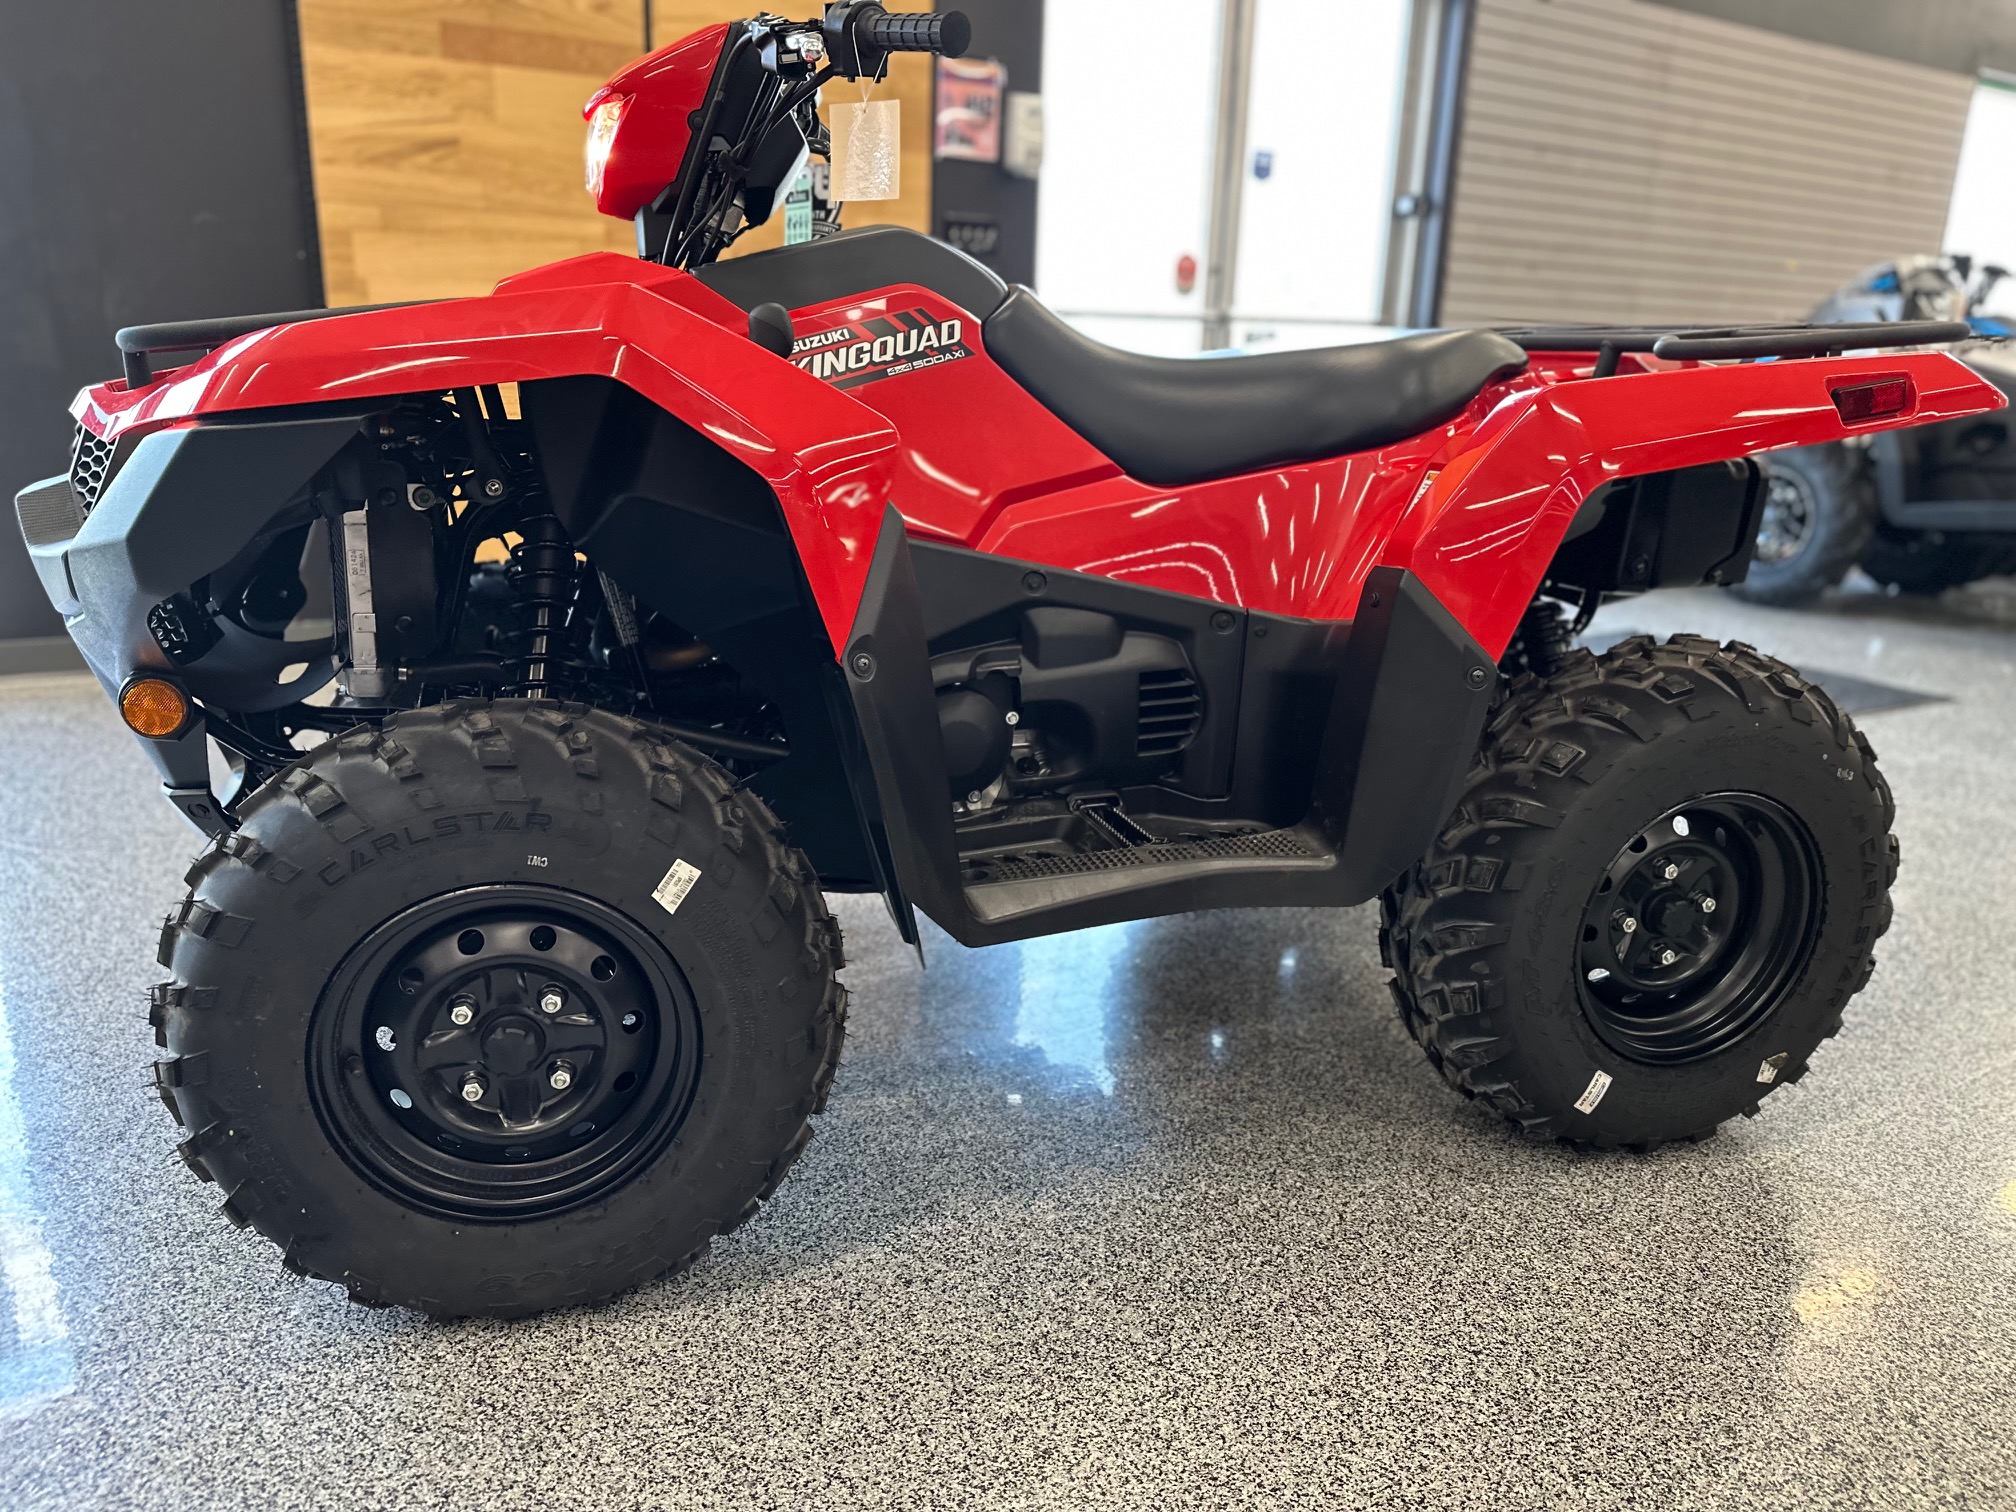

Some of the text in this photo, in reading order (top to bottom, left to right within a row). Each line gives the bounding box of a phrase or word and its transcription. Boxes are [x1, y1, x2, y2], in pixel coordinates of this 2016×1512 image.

[791, 328, 850, 354] SUZUKI
[317, 810, 553, 888] CARLSTAR
[1827, 836, 1878, 1008] CARLSTAR
[1579, 1073, 1602, 1107] CARLSTAR
